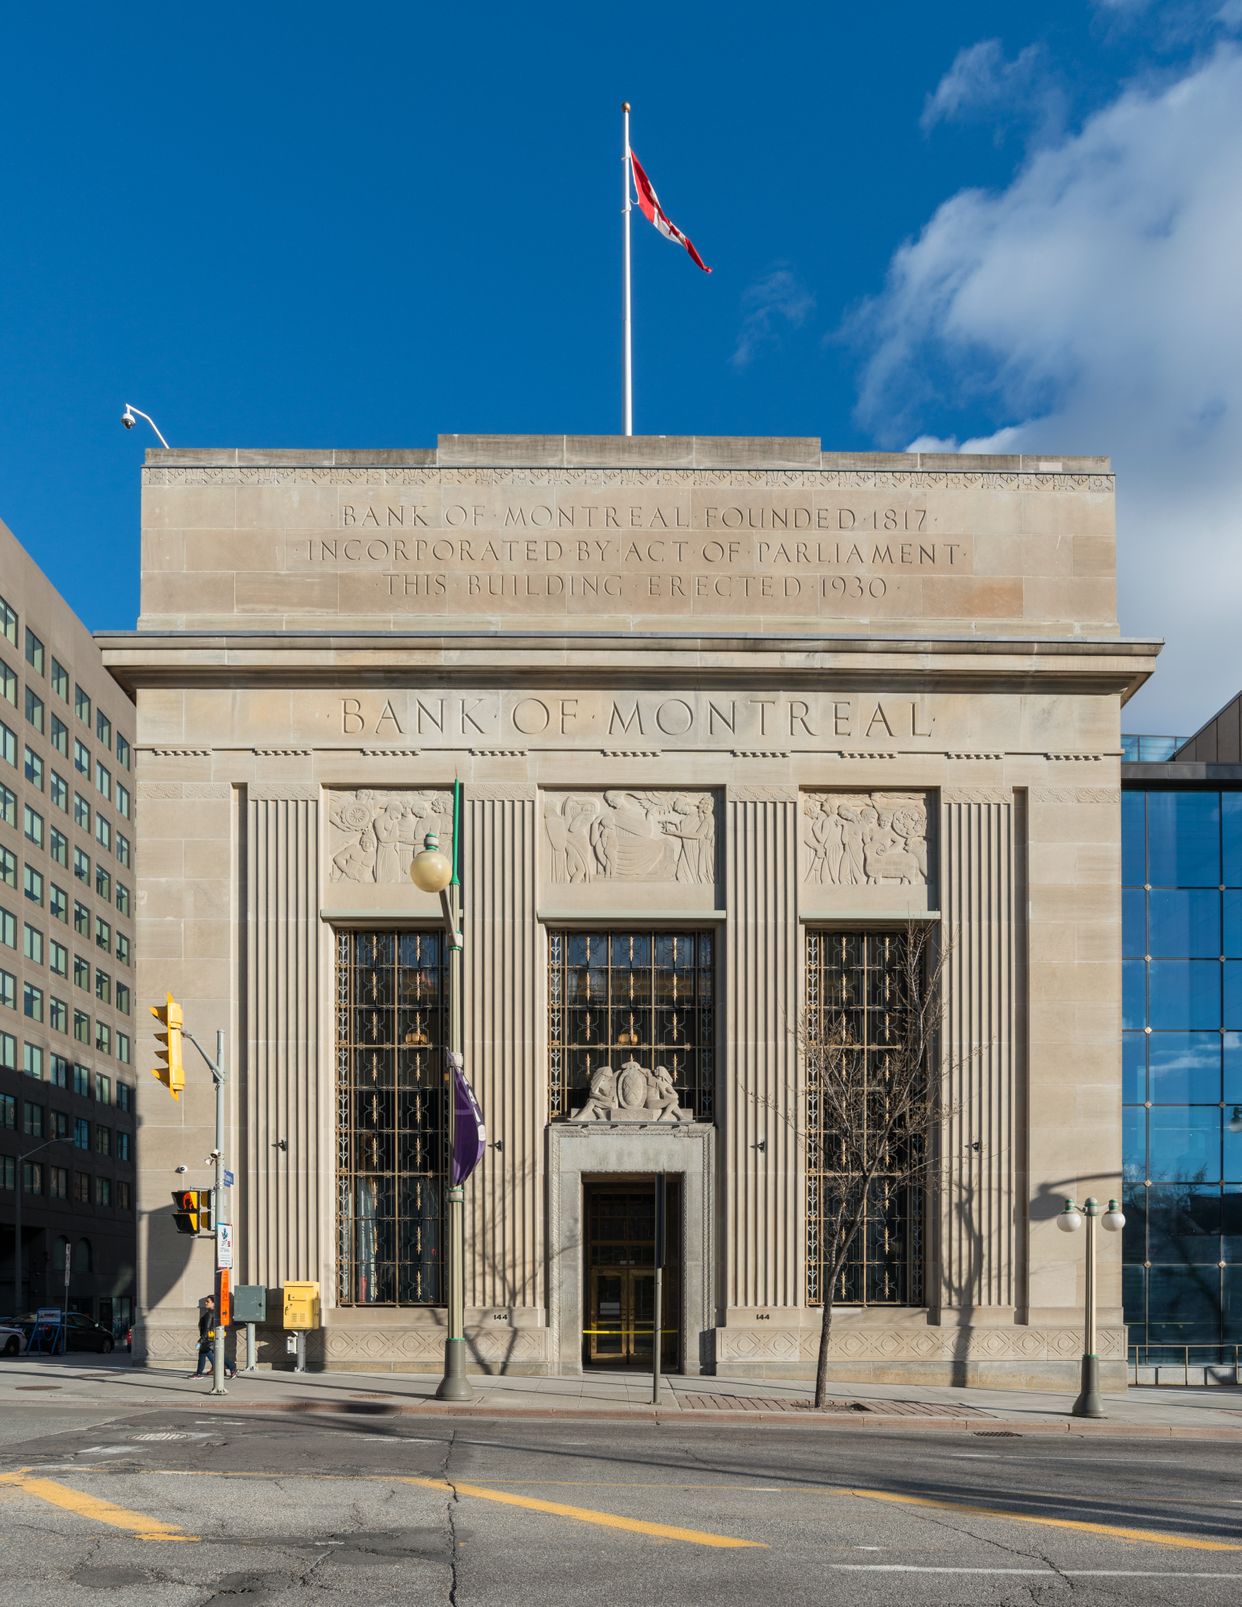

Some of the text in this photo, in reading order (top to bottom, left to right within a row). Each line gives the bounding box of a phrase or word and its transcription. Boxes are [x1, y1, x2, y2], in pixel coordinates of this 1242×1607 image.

[342, 505, 927, 530] BANK OF MONTREAL FOUNDED 1817
[307, 539, 960, 565] INCORPORATED BY ACT OF PARLIAMENT
[382, 574, 887, 599] THIS BUILDING ERECTED 1930
[340, 698, 934, 738] BANK OF MONTREAL
